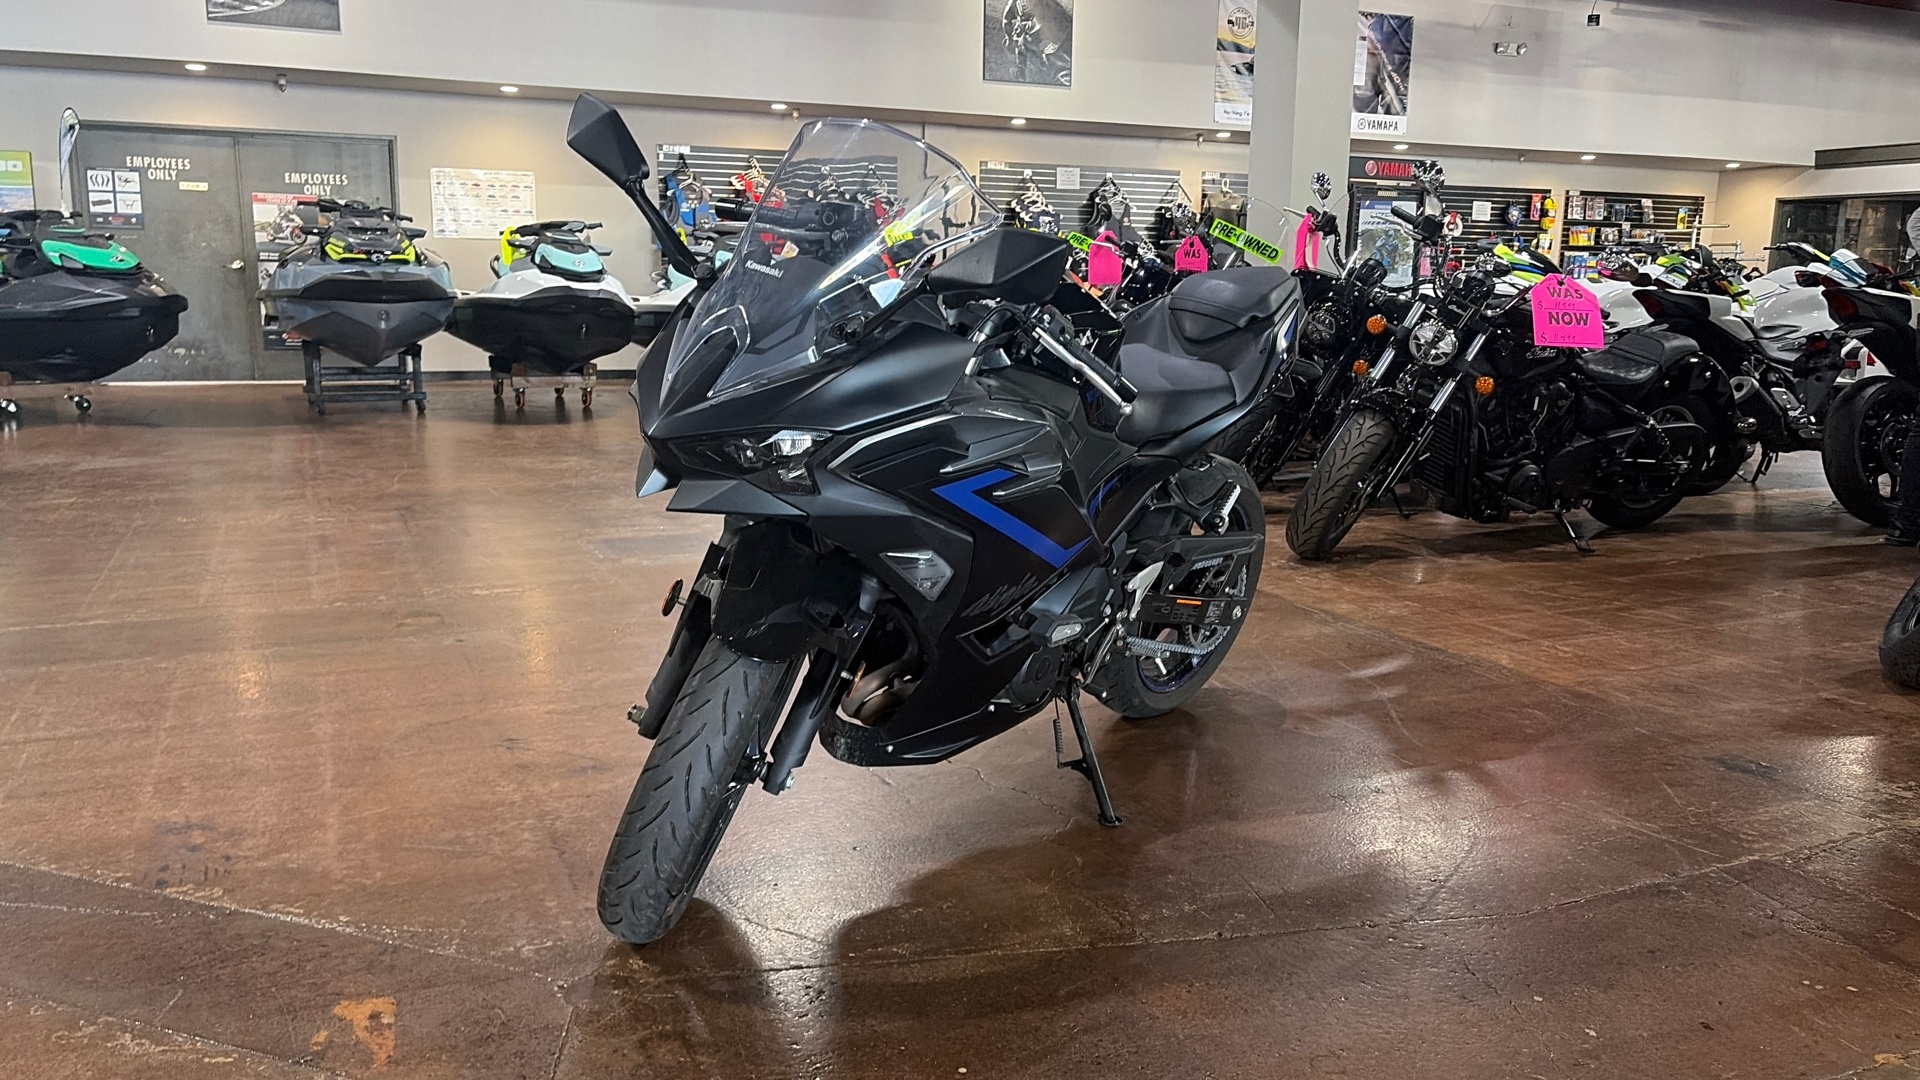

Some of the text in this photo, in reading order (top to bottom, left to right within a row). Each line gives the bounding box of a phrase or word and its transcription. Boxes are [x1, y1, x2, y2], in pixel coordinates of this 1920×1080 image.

[1223, 109, 1243, 117] Nohing
[1366, 119, 1399, 132] YAMAHA
[126, 156, 191, 170] EMPLOYEES
[1378, 162, 1414, 177] YAMAH
[147, 168, 178, 181] ONLY
[284, 172, 348, 185] EMPLOYEES
[303, 184, 332, 196] ONLY
[1069, 234, 1091, 248] PRE-
[1212, 221, 1280, 262] PRE-OWNED
[1184, 249, 1201, 259] WAS
[745, 259, 784, 278] Kawasaki
[1547, 286, 1583, 299] WAS
[1548, 311, 1590, 326] NOW
